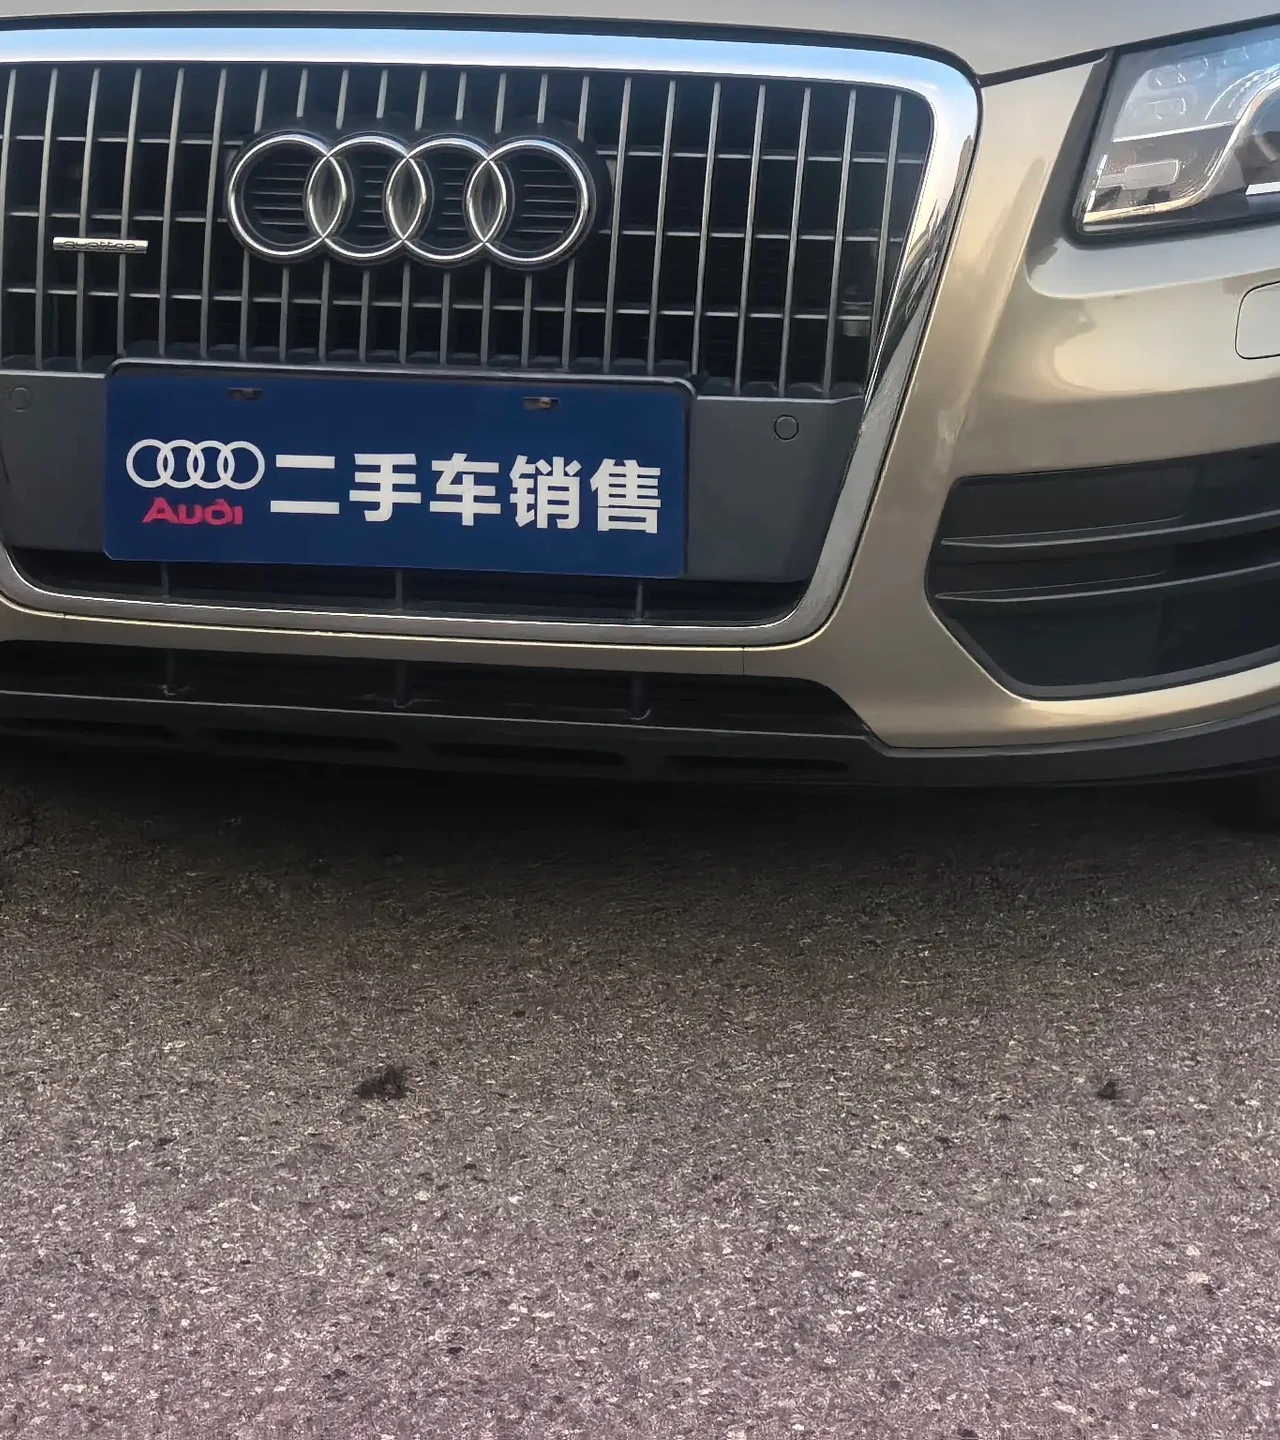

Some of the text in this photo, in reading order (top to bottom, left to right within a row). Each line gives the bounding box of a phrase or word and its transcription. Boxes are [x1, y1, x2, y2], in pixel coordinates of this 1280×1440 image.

[142, 496, 243, 526] Audi
[270, 452, 662, 534] 二手车销售
